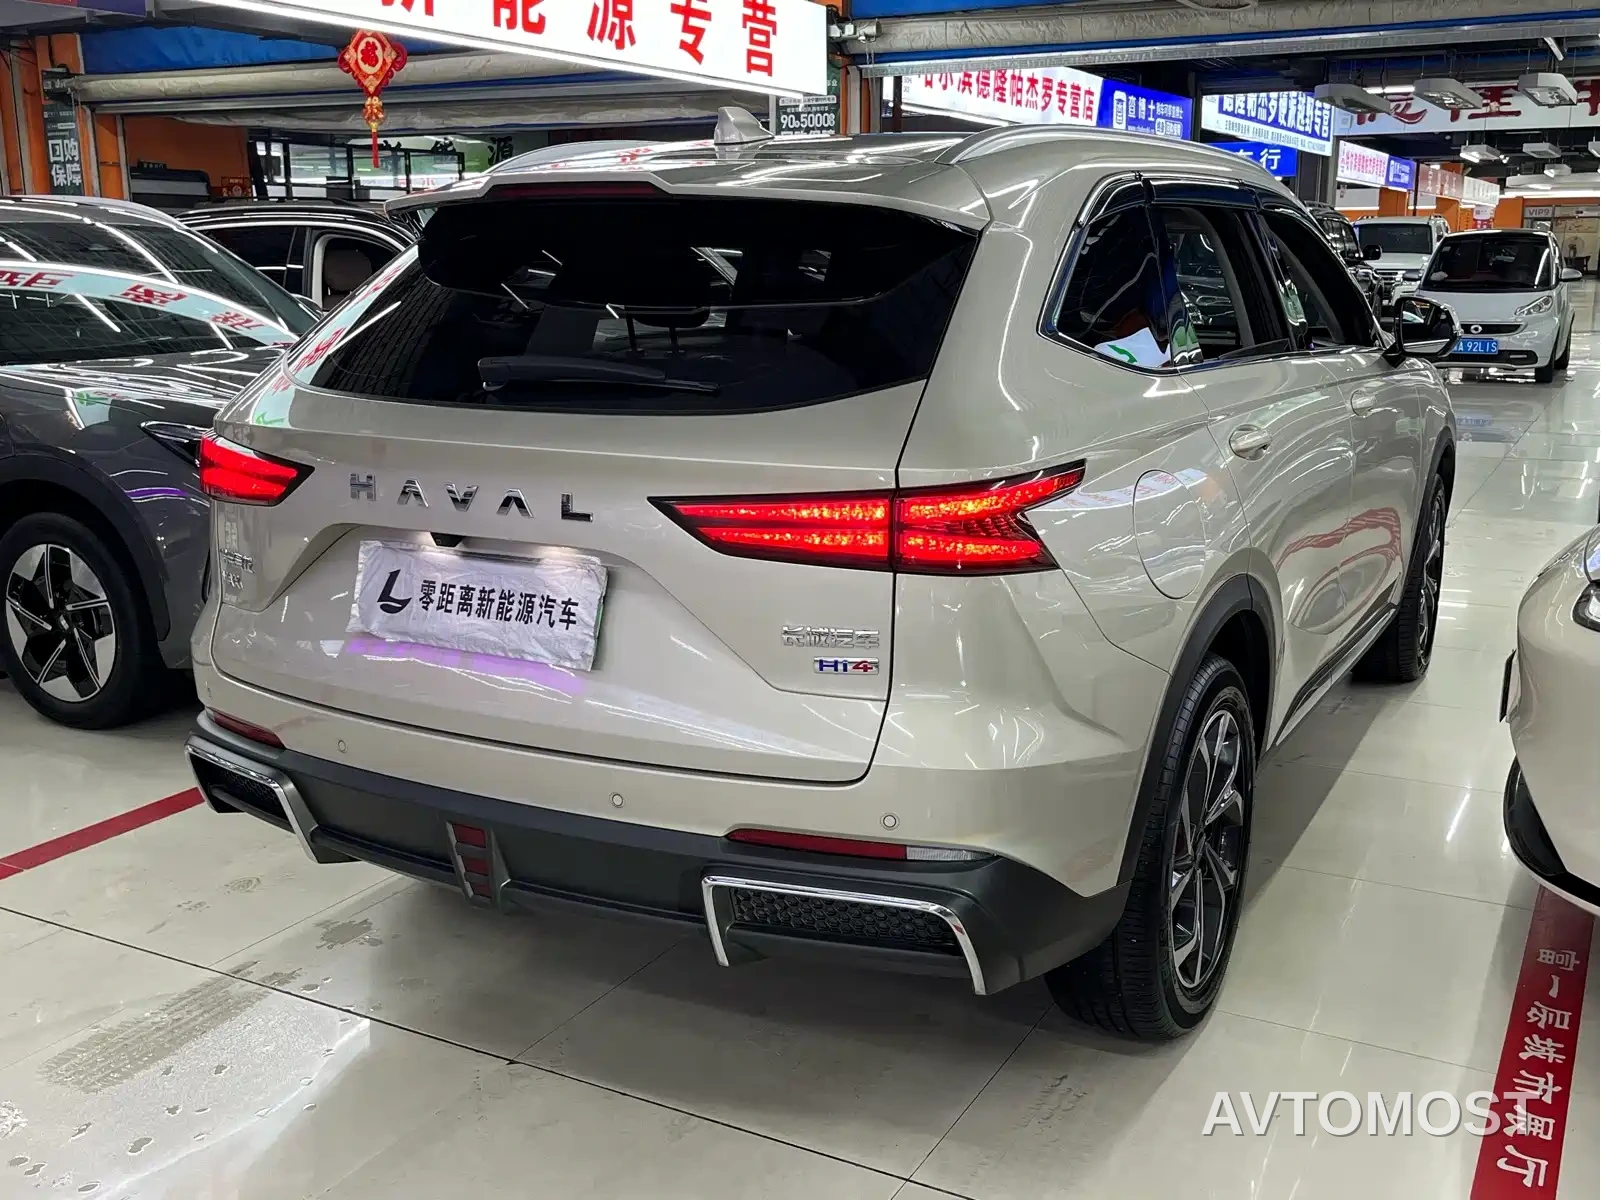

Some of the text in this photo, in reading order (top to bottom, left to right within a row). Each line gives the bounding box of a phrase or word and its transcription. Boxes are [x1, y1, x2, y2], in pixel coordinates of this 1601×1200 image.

[382, 0, 777, 77] 源专营
[1127, 95, 1155, 121] 查博士
[49, 139, 79, 162] 回购
[52, 162, 81, 187] 保障
[1528, 208, 1549, 216] VIP9
[349, 472, 594, 523] HAVAL
[419, 578, 579, 631] 零距离新能源汽车
[781, 625, 880, 650] 长城汽车
[818, 659, 874, 673] Hi4
